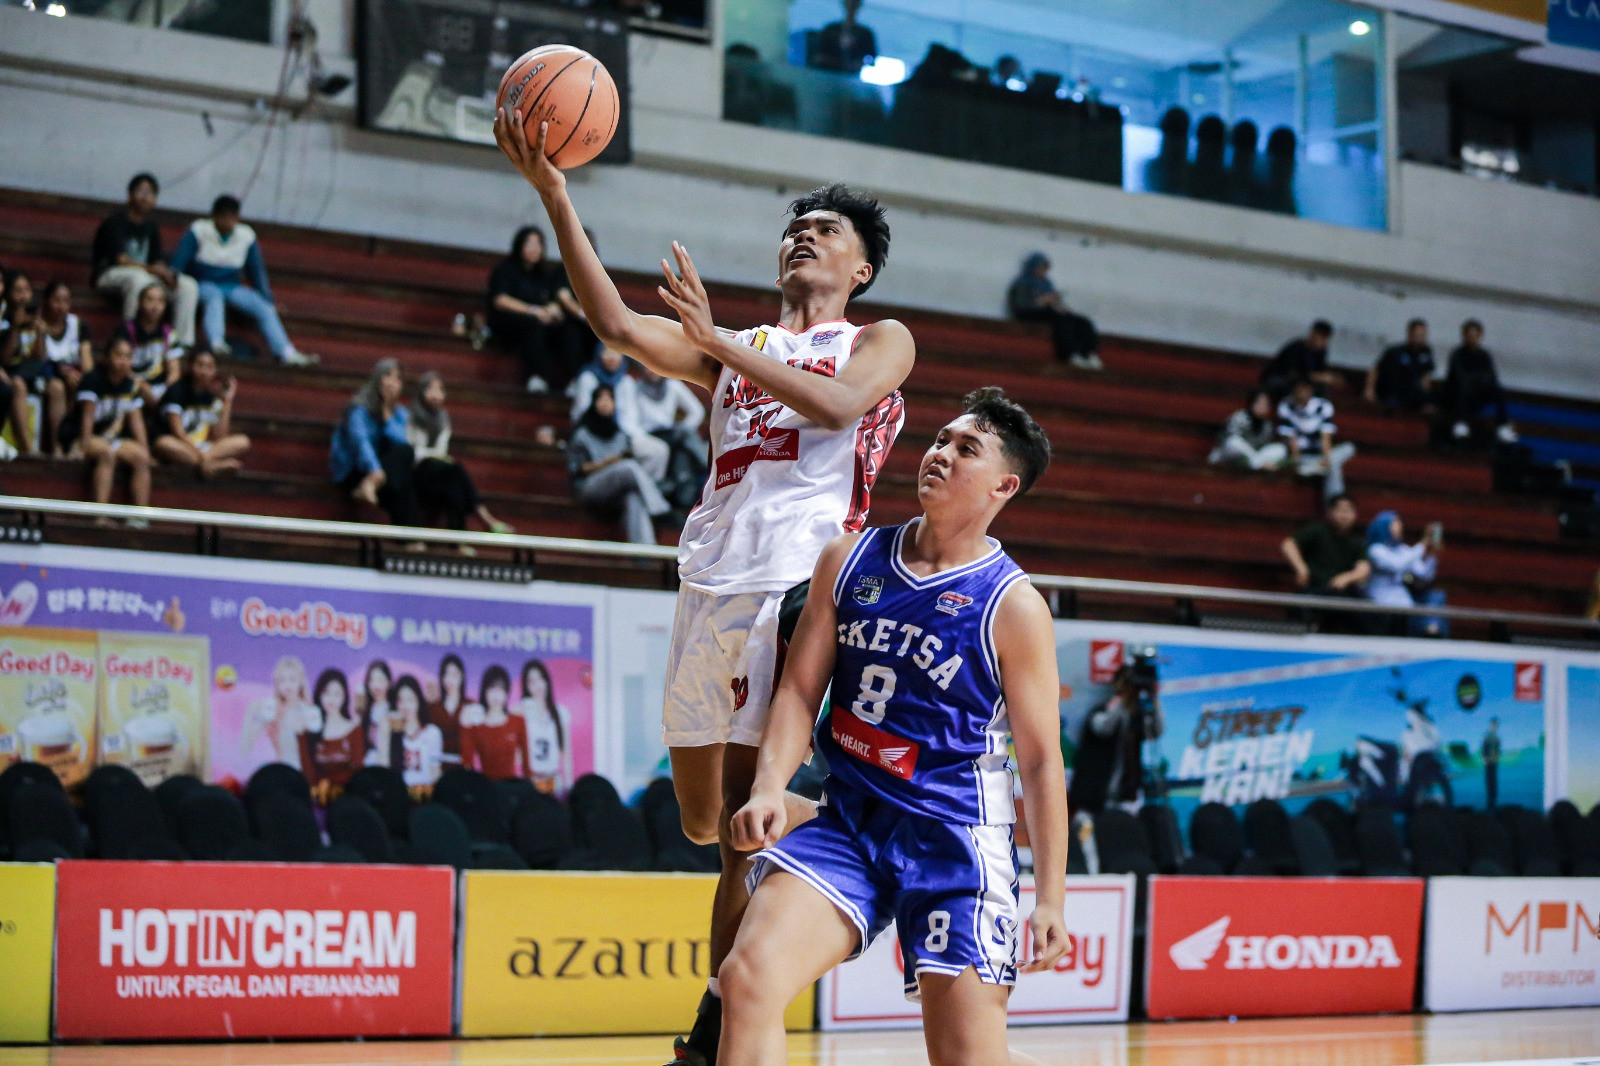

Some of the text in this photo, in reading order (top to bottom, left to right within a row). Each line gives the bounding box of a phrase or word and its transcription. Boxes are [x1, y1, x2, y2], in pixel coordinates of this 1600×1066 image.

[242, 598, 312, 637] Good
[312, 602, 367, 649] Day
[402, 618, 582, 654] BABYMONSTER
[851, 663, 897, 725] 8
[925, 910, 950, 953] 8
[1225, 934, 1402, 969] HONDA
[116, 975, 400, 998] UNTUK PEGAL DAN PEMANASAN
[1501, 970, 1596, 988] DISTRIBUTOR
